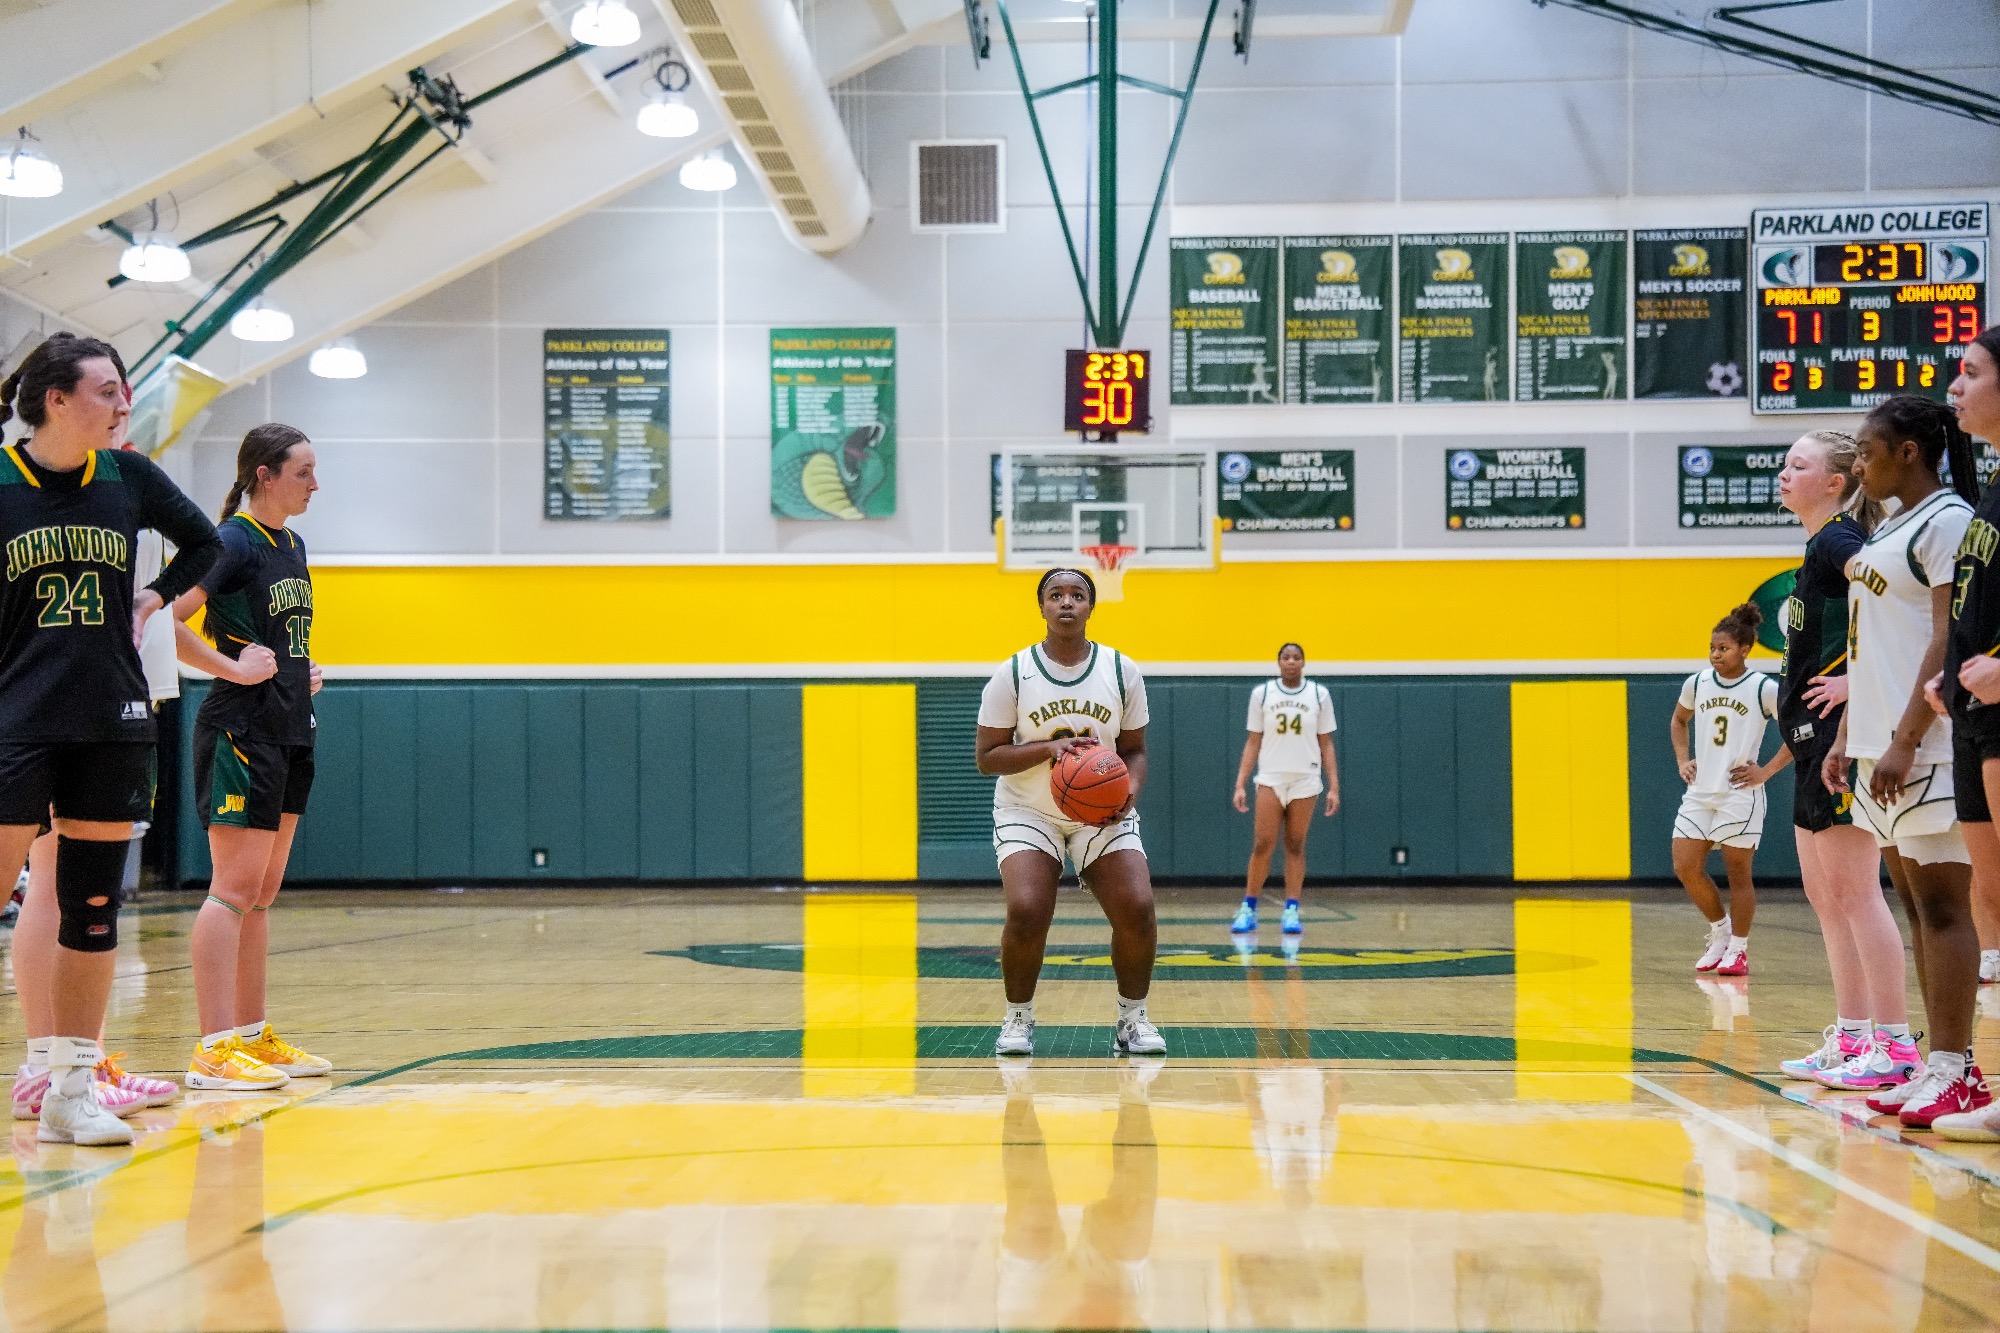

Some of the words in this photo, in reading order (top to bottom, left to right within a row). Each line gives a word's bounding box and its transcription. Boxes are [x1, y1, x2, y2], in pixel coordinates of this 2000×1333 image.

[1760, 213, 1875, 237] PARKLAND
[1881, 209, 1983, 232] COLLEGE
[1285, 238, 1342, 248] PARKLAND
[1343, 237, 1392, 247] COLLEGE
[1400, 236, 1457, 246] PARKLAND
[1458, 235, 1508, 245] COLLEGE
[1517, 234, 1574, 243] PARKLAND
[1576, 232, 1626, 242] COLLEGE
[1636, 231, 1694, 241] PARKLAND
[1695, 229, 1746, 240] COLLEGE
[1171, 239, 1228, 249] PARKLAND
[1229, 238, 1278, 249] COLLEGE
[1841, 243, 1923, 282] 2:37
[1315, 284, 1361, 299] MEN'S
[1423, 284, 1483, 298] WOMEN'S
[1548, 282, 1594, 298] MEN'S
[1639, 280, 1684, 294] MEN'S
[1685, 279, 1742, 293] SOCCER
[1188, 289, 1261, 303] BASEBALL
[1293, 296, 1383, 311] BASKETBALL
[1415, 296, 1492, 309] BASKETBALL
[1552, 296, 1590, 311] GOLF
[1765, 287, 1841, 306] PARKLAND
[1849, 295, 1891, 310] PERIOD
[1776, 308, 1822, 345] 71
[1863, 311, 1880, 341] 3
[1933, 305, 1979, 343] 33
[547, 340, 611, 352] PARKLAND
[611, 340, 667, 352] COLLEGE
[773, 339, 836, 351] PARKLAND
[1945, 345, 1966, 359] FOU
[1759, 348, 1796, 363] FOULS
[1831, 347, 1875, 362] PLAYER
[1881, 346, 1910, 361] FOUL
[546, 358, 598, 370] Athletes
[599, 358, 614, 370] of
[615, 358, 637, 370] the
[638, 358, 668, 370] Year
[773, 357, 825, 368] Athletes
[826, 356, 840, 368] of
[841, 356, 863, 368] the
[864, 356, 893, 368] Year
[1085, 353, 1144, 381] 2:37
[1773, 361, 1792, 392] 2
[1808, 366, 1823, 390] 3
[1858, 359, 1876, 390] 3
[1896, 360, 1905, 387] 1
[1920, 363, 1935, 387] 2
[1082, 381, 1133, 425] 30
[1760, 395, 1796, 409] SCORE
[1280, 452, 1323, 467] MEN'S
[1497, 450, 1563, 465] WOMEN'S
[1745, 452, 1785, 469] GOLF
[1257, 466, 1346, 482] BASKETBALL
[1485, 464, 1576, 480] BASKETBALL
[1236, 518, 1336, 530] CHAMPIONSHIPS
[1465, 515, 1566, 528] CHAMPIONSHIPS
[1698, 512, 1800, 526] CHAMPIONSHIPS
[6, 525, 64, 583] JOHN
[64, 525, 127, 572] WOOD
[36, 571, 104, 628] 24
[268, 577, 300, 617] JOHN
[1028, 698, 1112, 728] PARKLAND
[1270, 700, 1310, 713] PARKLAND
[1699, 696, 1749, 716] PARKLAND
[1275, 713, 1303, 736] 34
[1713, 715, 1728, 747] 3
[217, 794, 246, 815] JW
